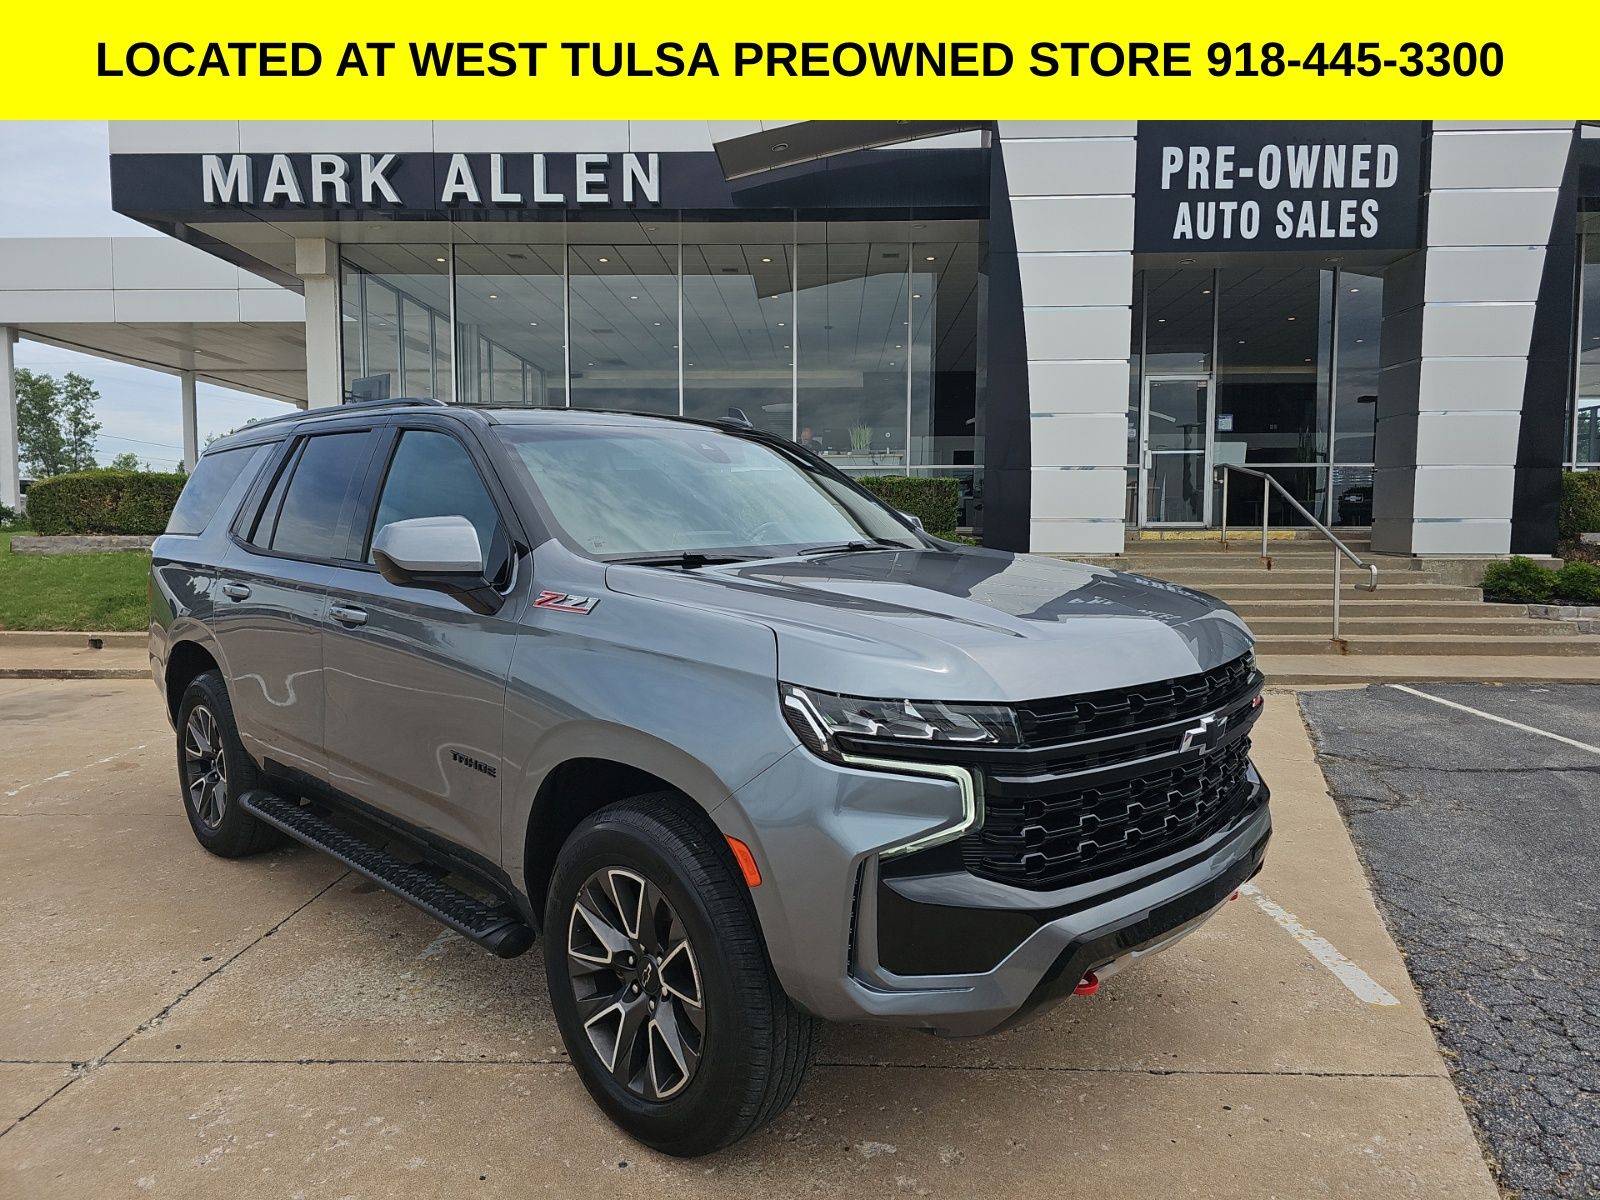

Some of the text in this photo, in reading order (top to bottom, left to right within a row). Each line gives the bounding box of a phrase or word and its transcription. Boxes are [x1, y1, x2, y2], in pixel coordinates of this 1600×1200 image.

[201, 153, 661, 205] MARK ALLEN
[1161, 144, 1399, 190] PRE-OWNED
[1172, 198, 1379, 240] AUTO SALES
[532, 590, 601, 615] Z71
[449, 749, 497, 778] TAHOE
